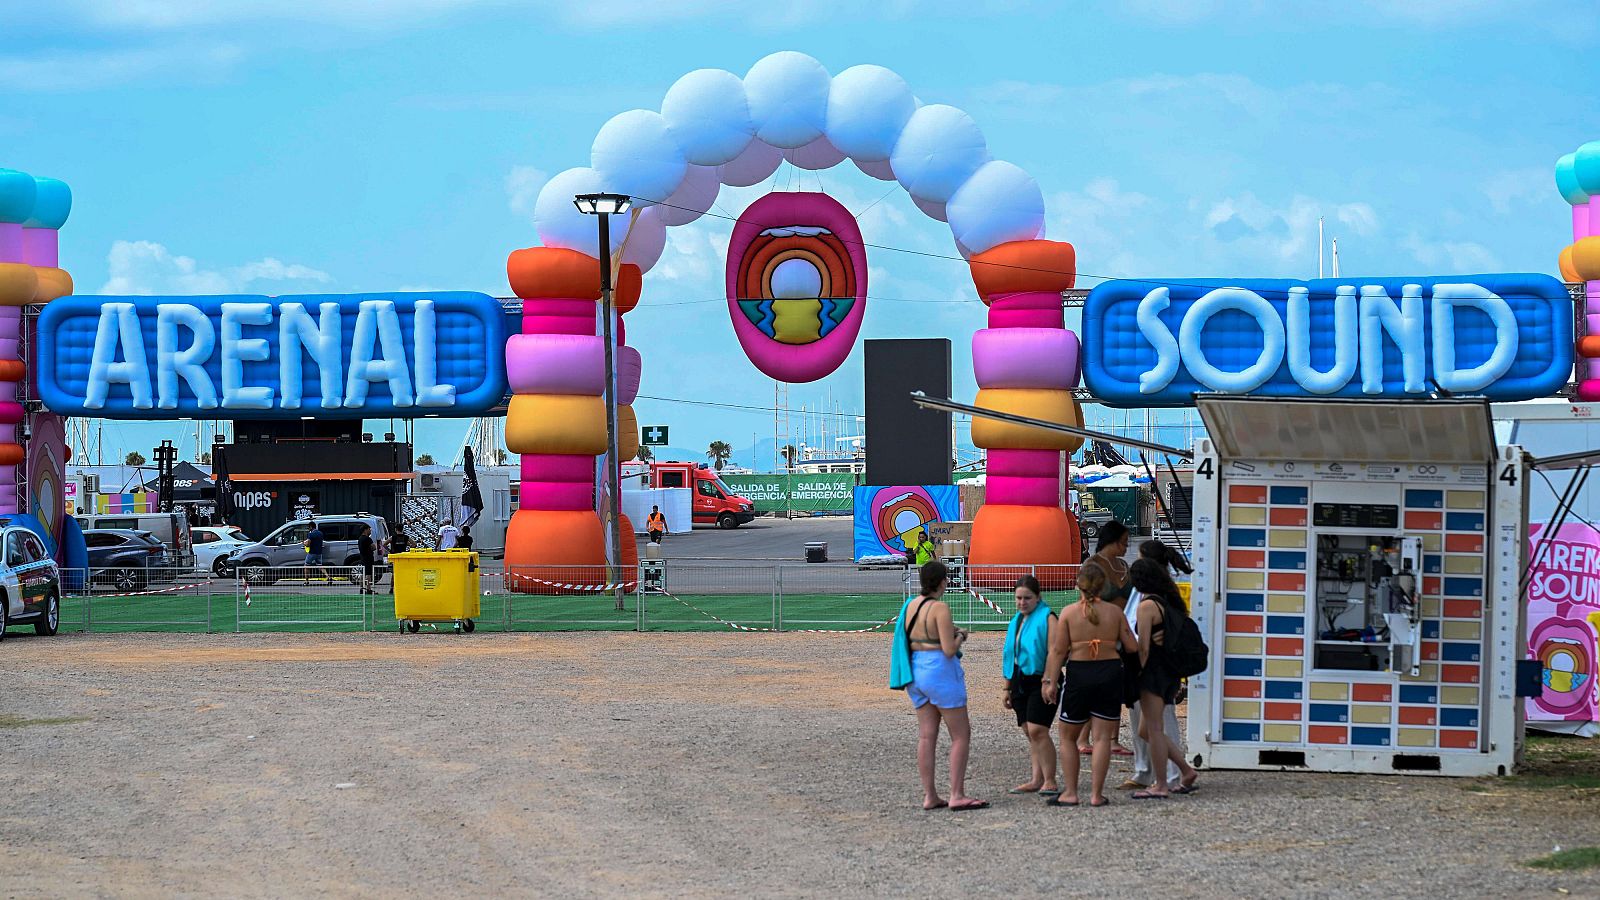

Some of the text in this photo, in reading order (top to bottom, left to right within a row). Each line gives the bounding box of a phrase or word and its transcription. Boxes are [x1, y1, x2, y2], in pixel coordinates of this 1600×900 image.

[1137, 283, 1519, 395] SOUND
[83, 300, 456, 409] ARENAL
[1196, 457, 1214, 480] 4
[1499, 463, 1517, 487] 4
[730, 484, 780, 492] SALIDA DE
[791, 491, 854, 500] EMERGENCIA
[797, 483, 831, 491] SALIDA
[233, 491, 272, 511] nipes
[1532, 571, 1600, 604] SOUN
